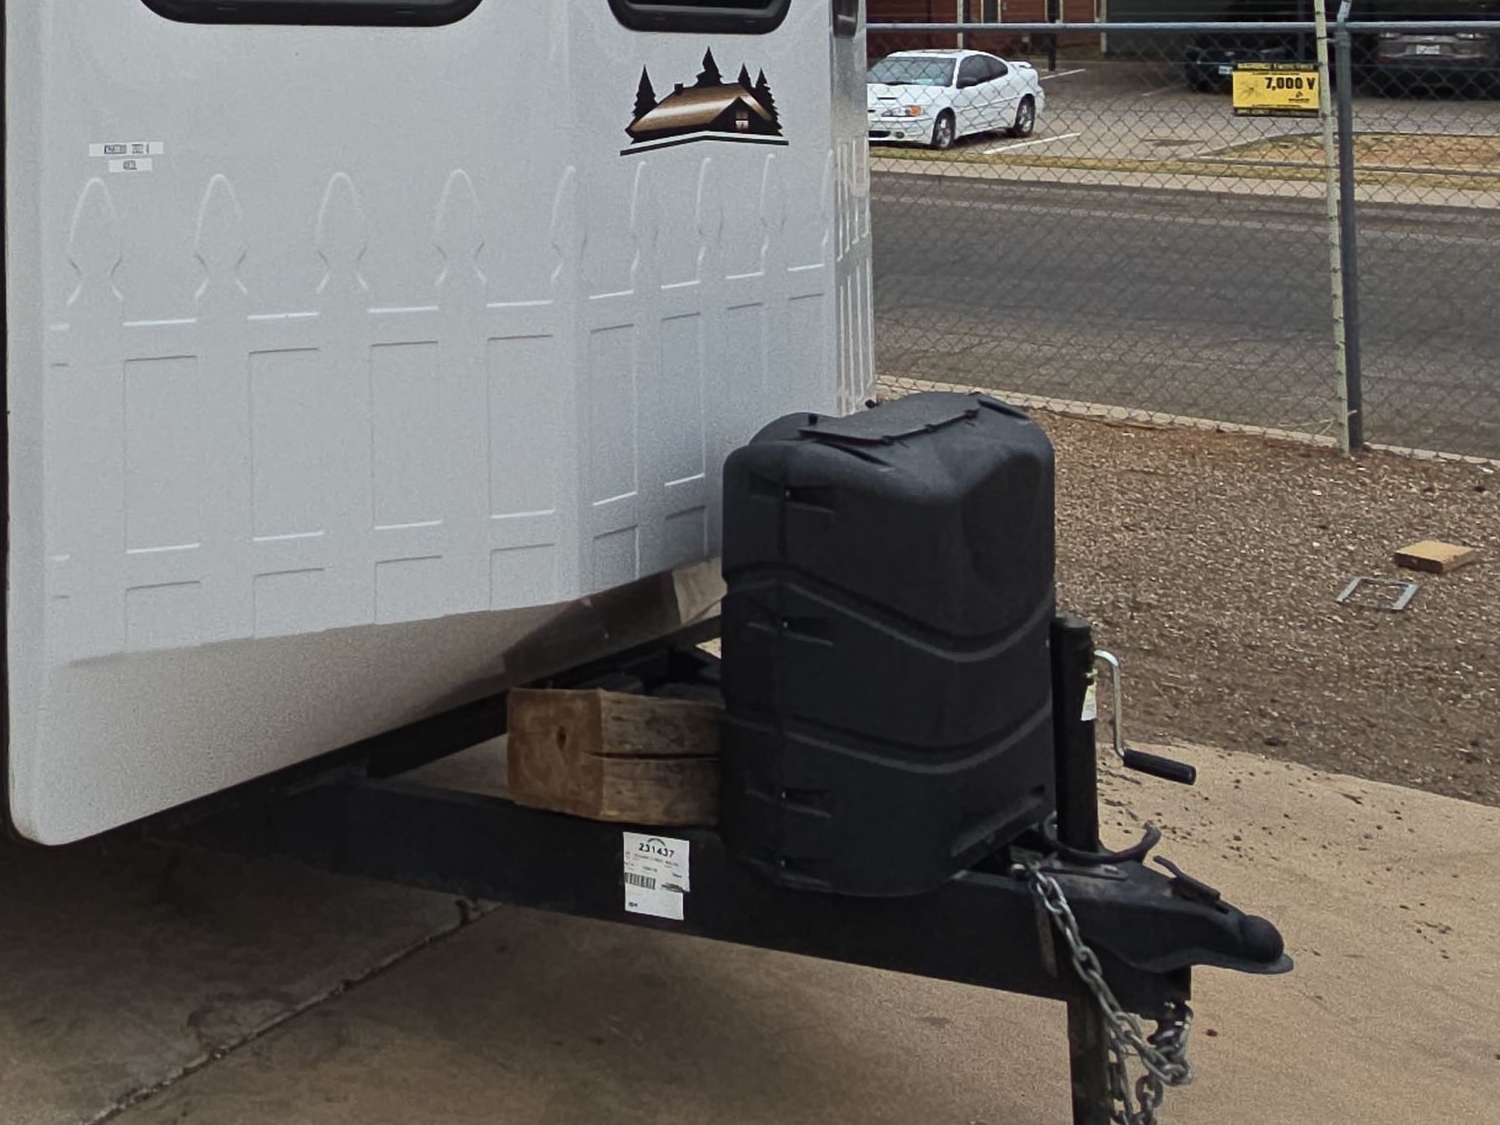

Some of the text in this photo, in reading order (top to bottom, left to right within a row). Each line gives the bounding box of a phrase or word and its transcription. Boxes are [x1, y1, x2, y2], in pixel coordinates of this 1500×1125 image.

[1265, 77, 1316, 91] 7,000 V
[638, 842, 675, 858] 231437
